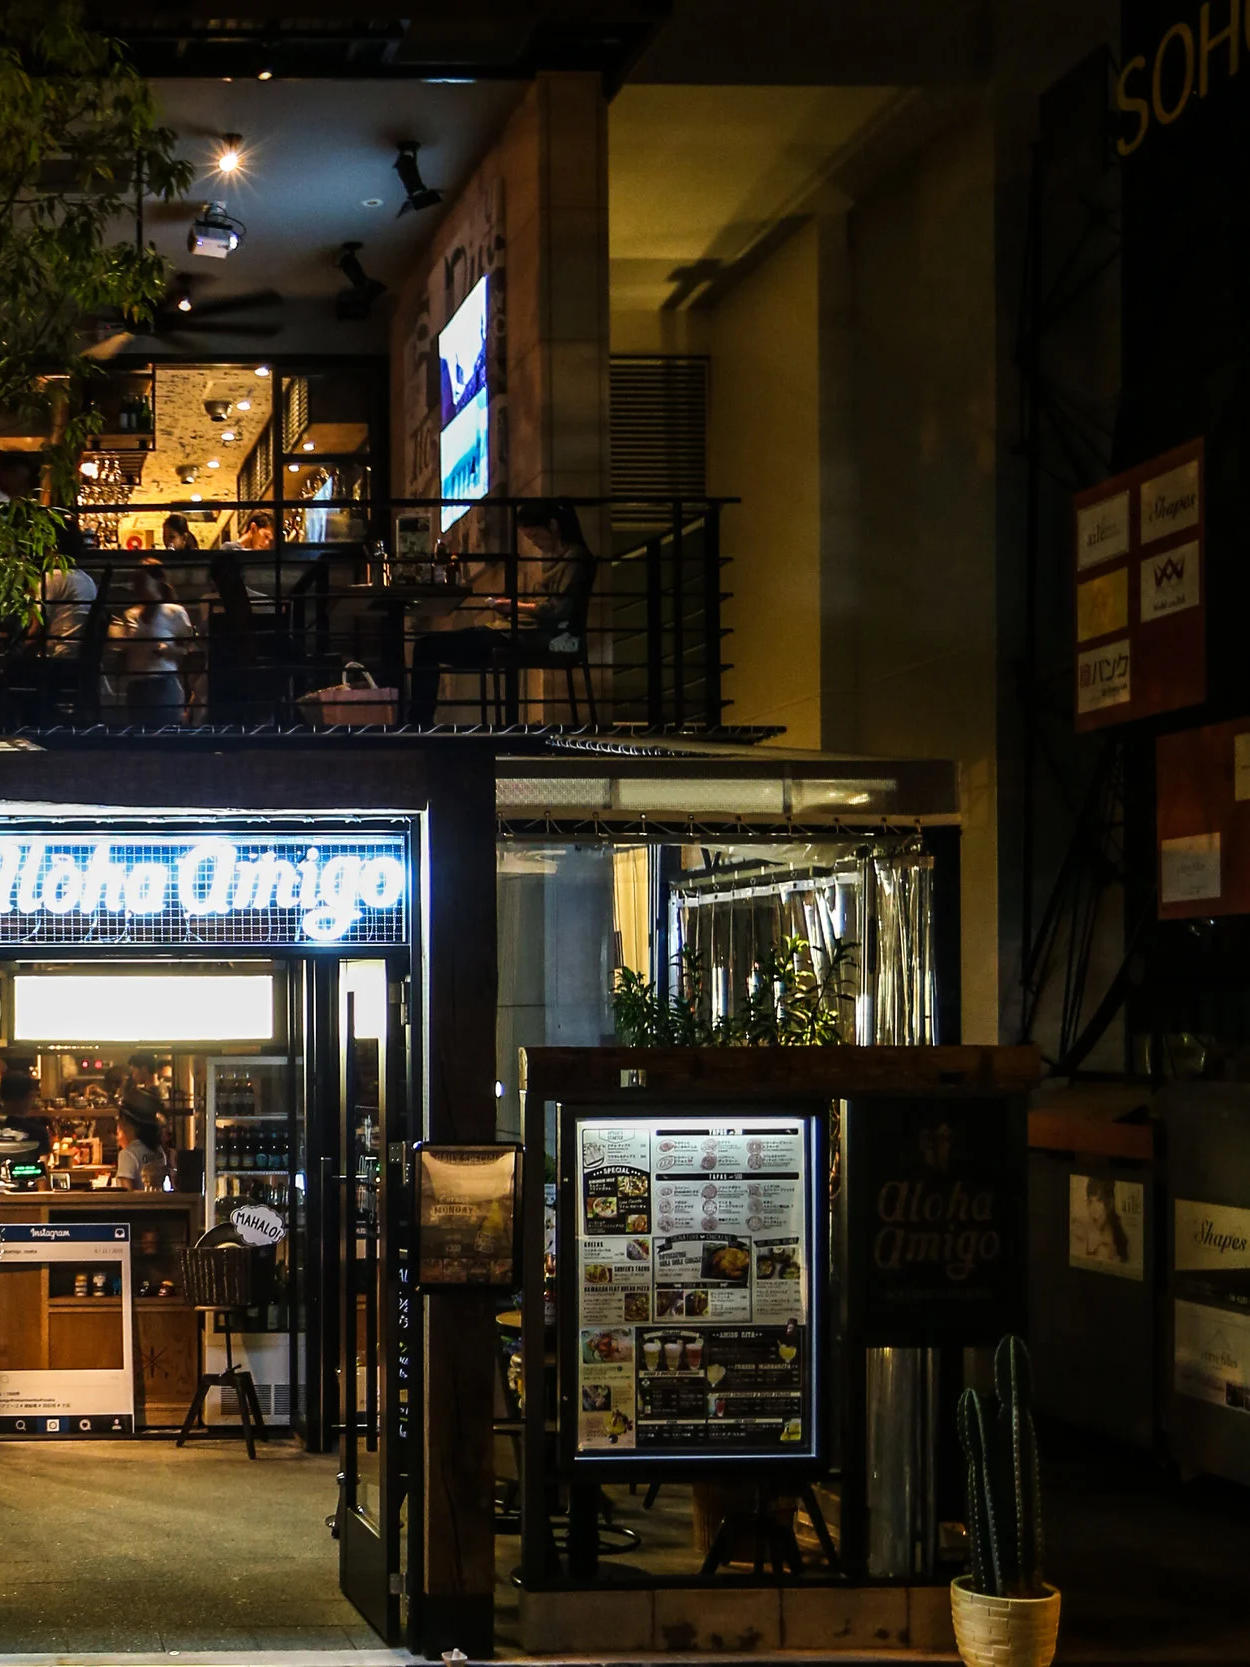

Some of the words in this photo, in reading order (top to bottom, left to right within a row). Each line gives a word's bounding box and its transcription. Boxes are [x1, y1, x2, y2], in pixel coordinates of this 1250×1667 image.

[1149, 493, 1197, 524] Shapes
[603, 1167, 630, 1176] SPECIAL
[30, 1227, 71, 1240] Instagram
[1194, 1217, 1248, 1254] Shapes
